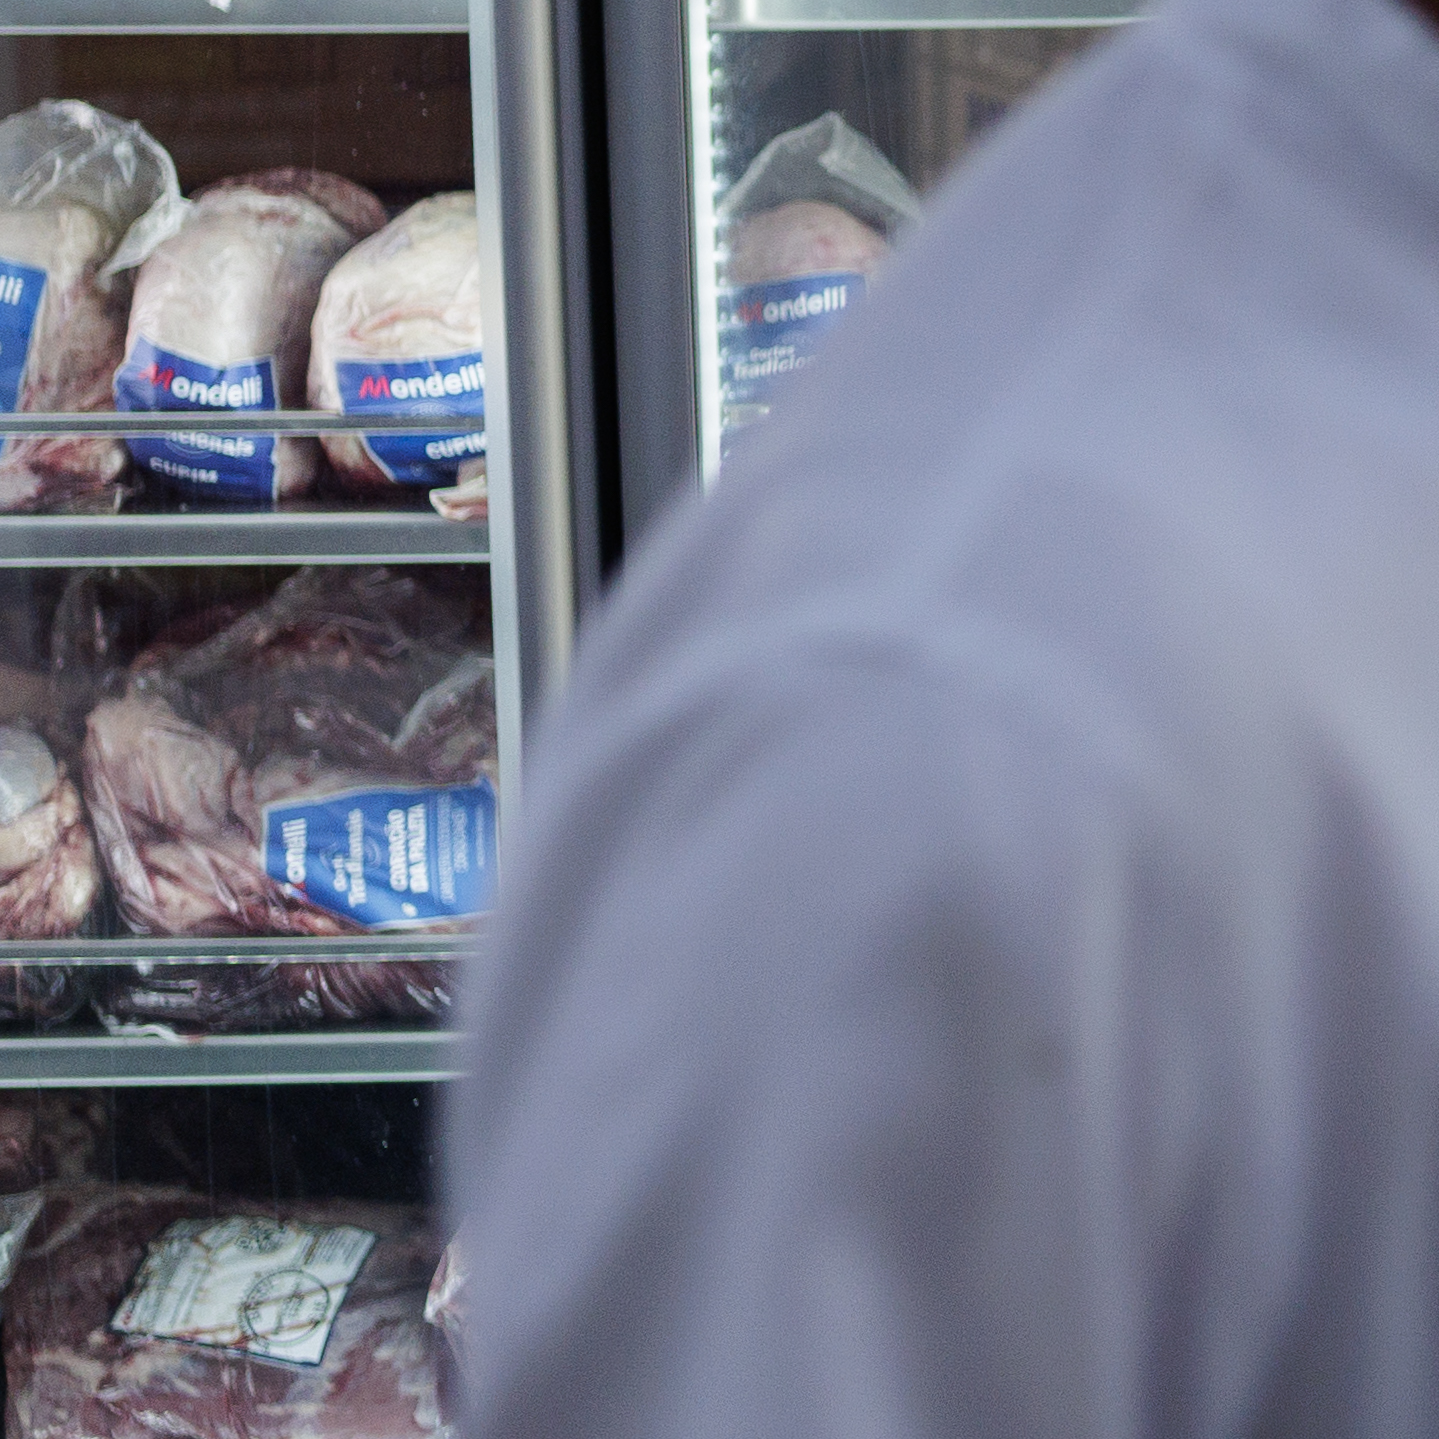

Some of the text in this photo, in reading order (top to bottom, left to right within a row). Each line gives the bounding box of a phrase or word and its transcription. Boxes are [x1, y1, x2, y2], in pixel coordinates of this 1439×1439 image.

[737, 284, 847, 324] Mondelli
[138, 362, 263, 407] Mondelli
[150, 457, 218, 483] CUPIM
